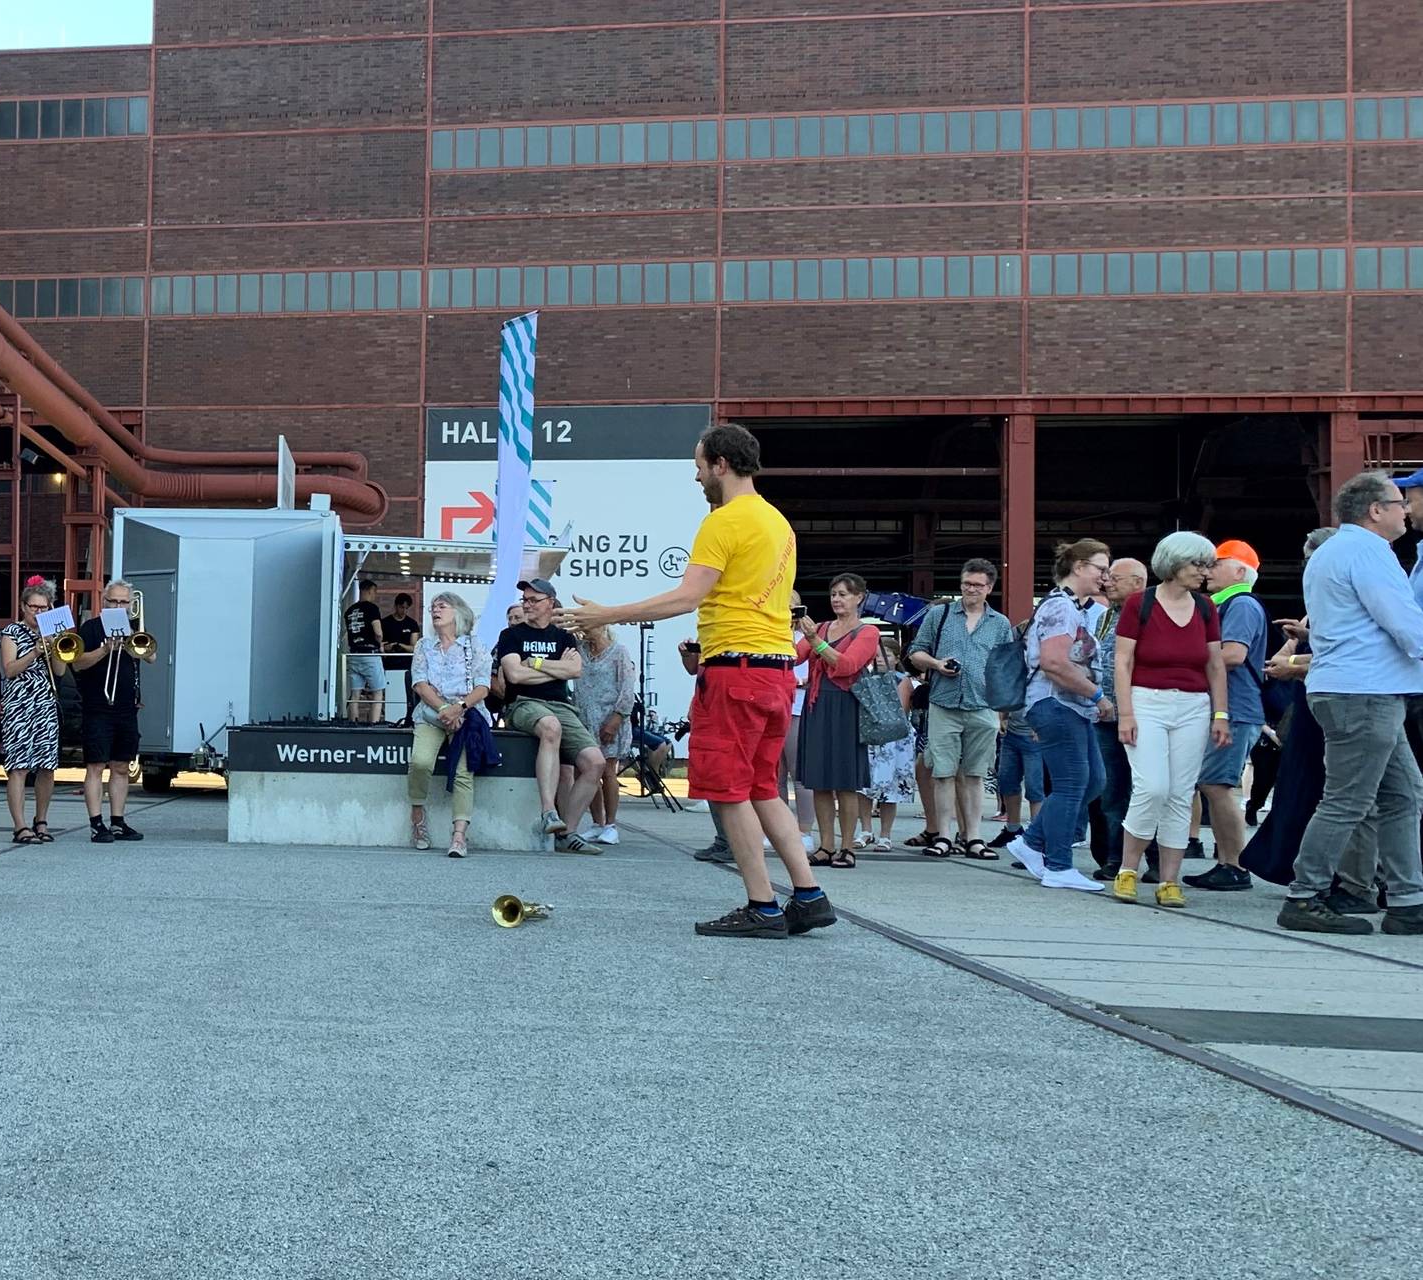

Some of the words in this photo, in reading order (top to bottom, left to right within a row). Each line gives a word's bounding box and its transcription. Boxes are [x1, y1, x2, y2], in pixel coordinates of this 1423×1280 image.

[441, 421, 497, 444] HAL
[541, 420, 573, 443] 12
[618, 534, 648, 553] ZU
[569, 559, 649, 577] SHOPS
[523, 640, 557, 653] HEIMAT
